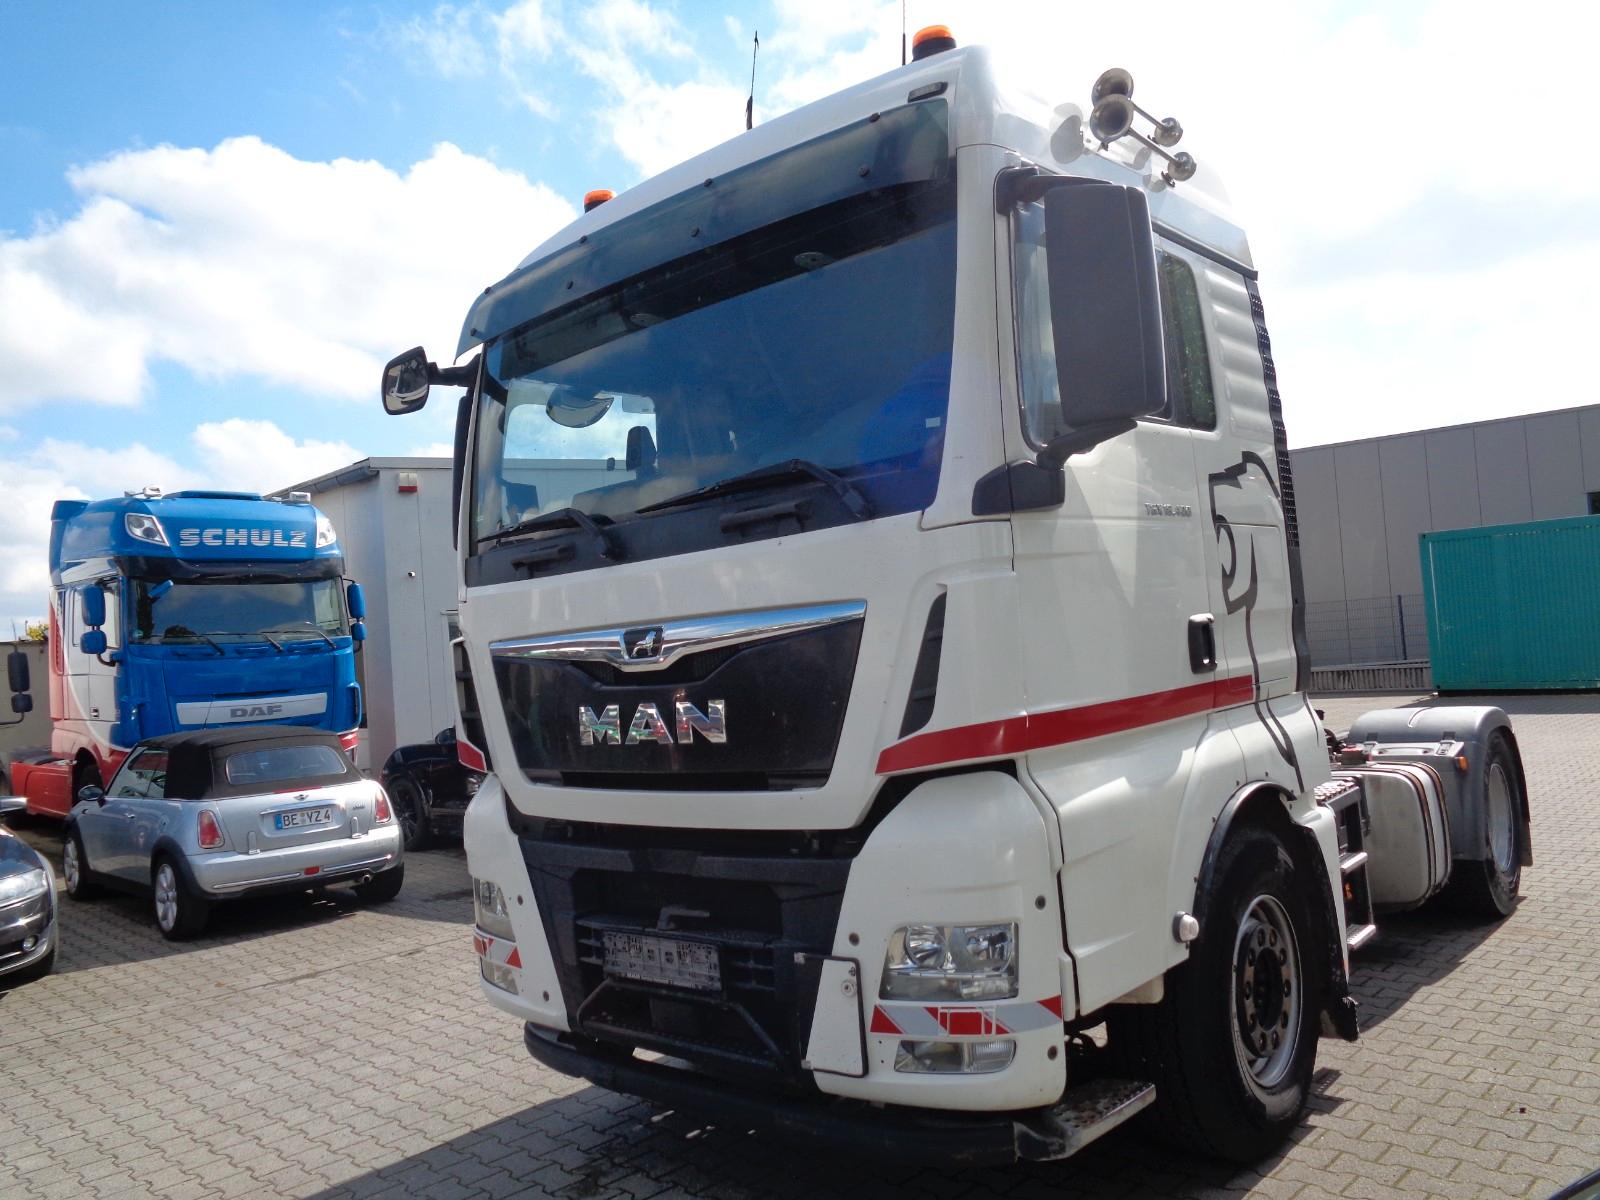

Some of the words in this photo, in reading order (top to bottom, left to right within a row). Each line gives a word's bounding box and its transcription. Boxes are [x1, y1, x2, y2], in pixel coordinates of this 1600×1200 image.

[179, 528, 307, 548] SCHULZ
[230, 705, 283, 718] DAF
[578, 700, 727, 745] MAN
[282, 813, 299, 826] BE
[306, 811, 322, 823] YZ
[324, 809, 331, 821] 4
